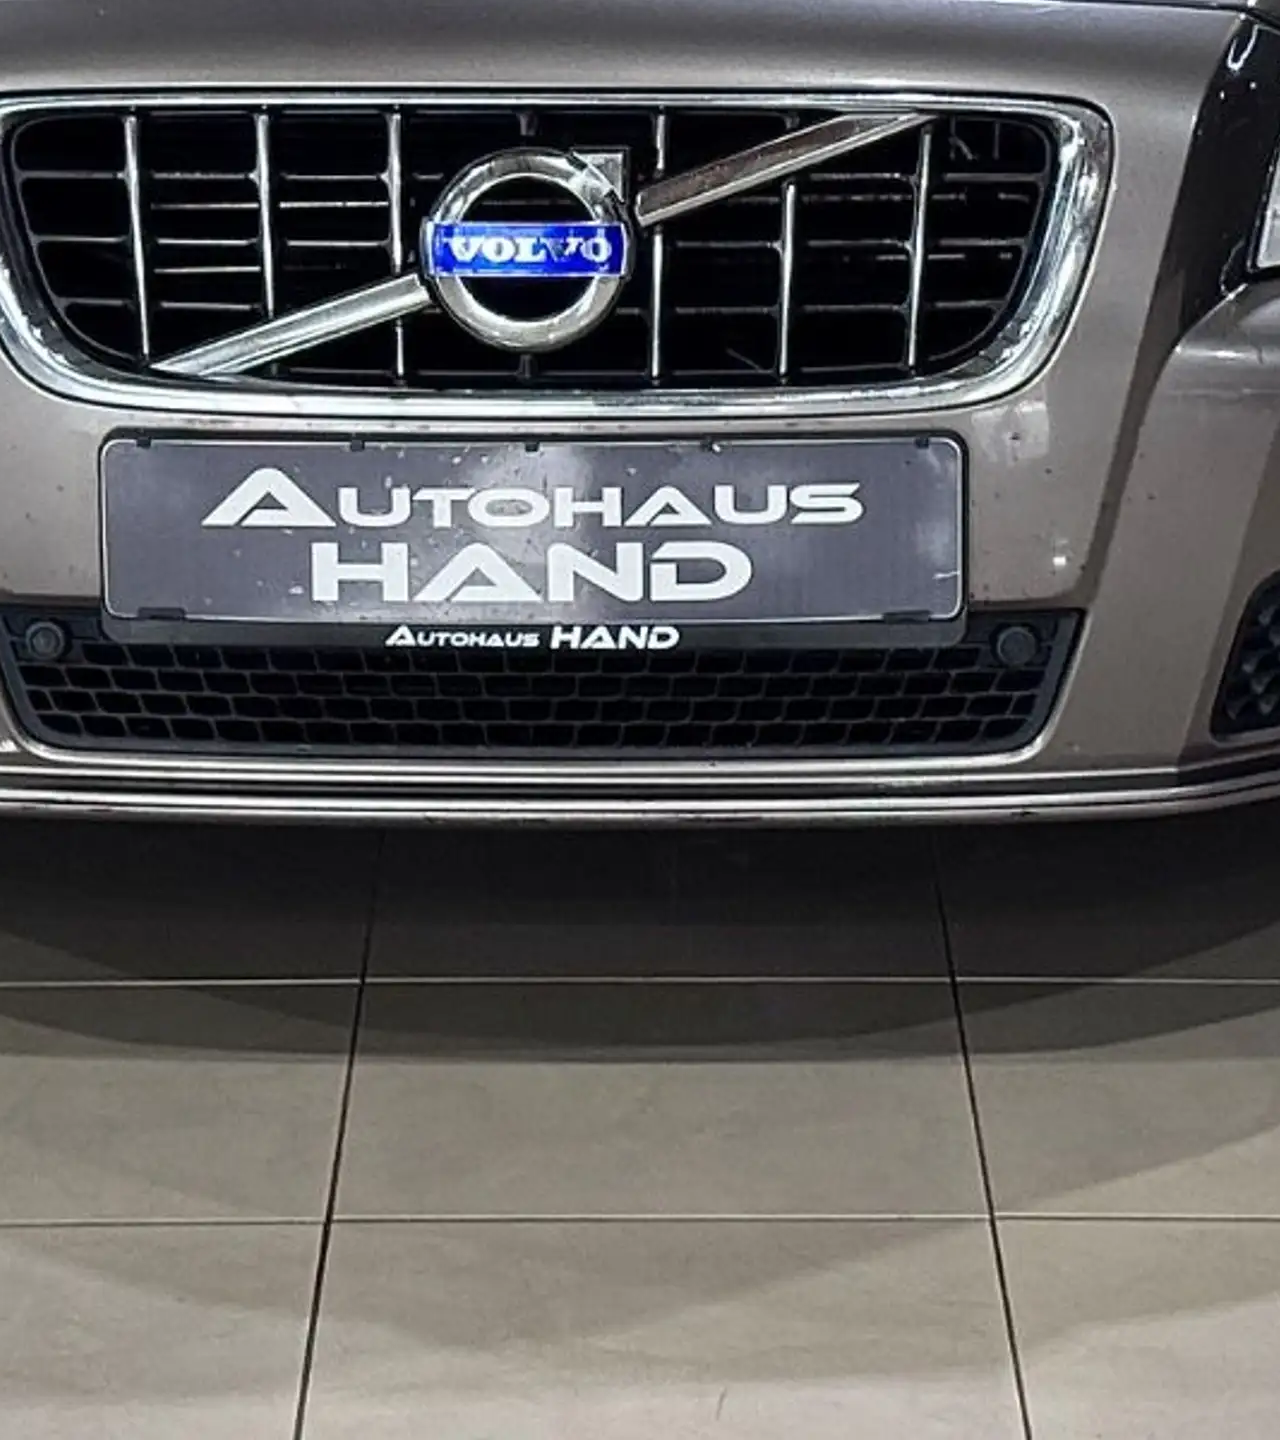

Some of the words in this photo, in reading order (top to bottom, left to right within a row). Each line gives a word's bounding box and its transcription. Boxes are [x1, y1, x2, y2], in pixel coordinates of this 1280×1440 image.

[442, 234, 613, 264] VOLVO
[201, 466, 864, 528] AUTOHAUS
[311, 540, 753, 603] HAND
[549, 625, 681, 650] HAND
